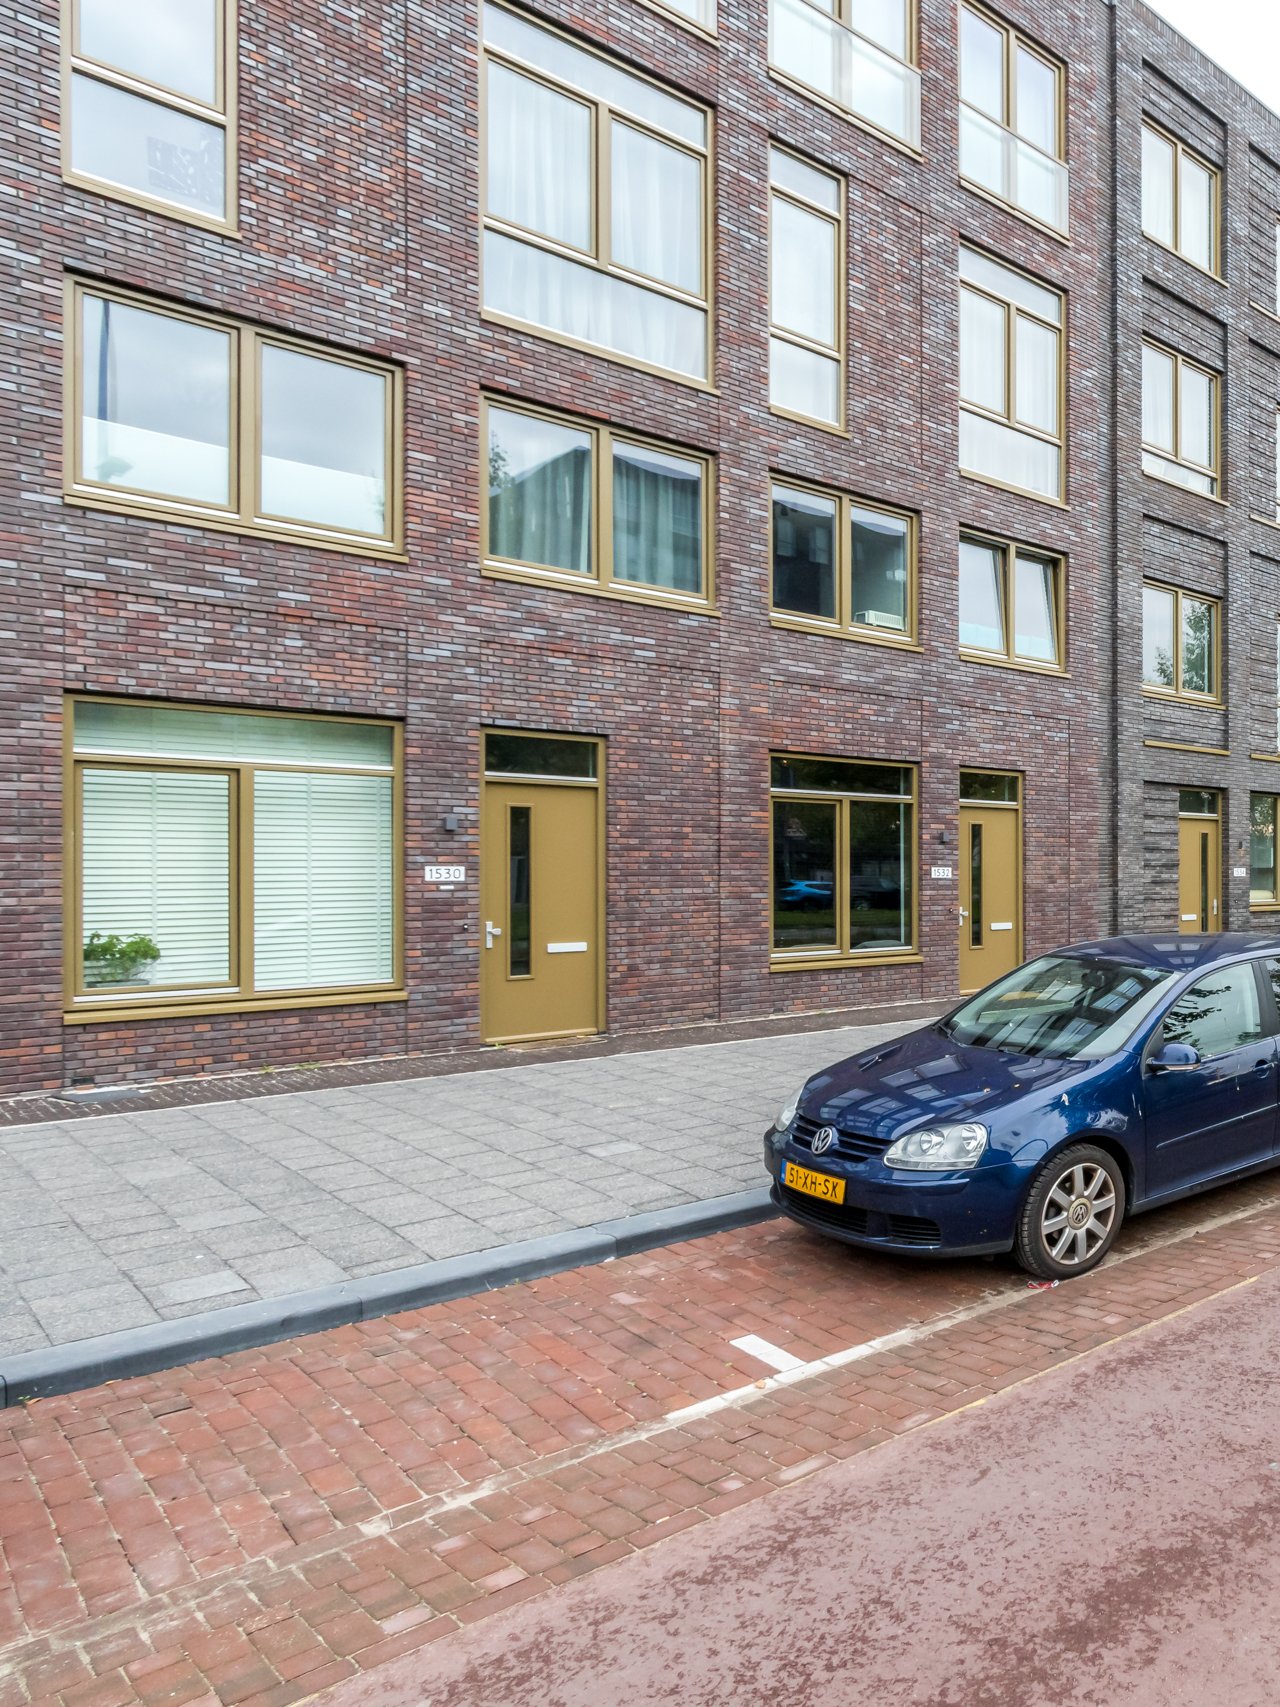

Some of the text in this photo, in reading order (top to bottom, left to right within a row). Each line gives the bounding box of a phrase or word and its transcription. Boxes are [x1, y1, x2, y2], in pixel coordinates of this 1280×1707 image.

[428, 868, 462, 880] 1530
[933, 868, 950, 877] 1532
[788, 1166, 839, 1199] 51-XH-SK
